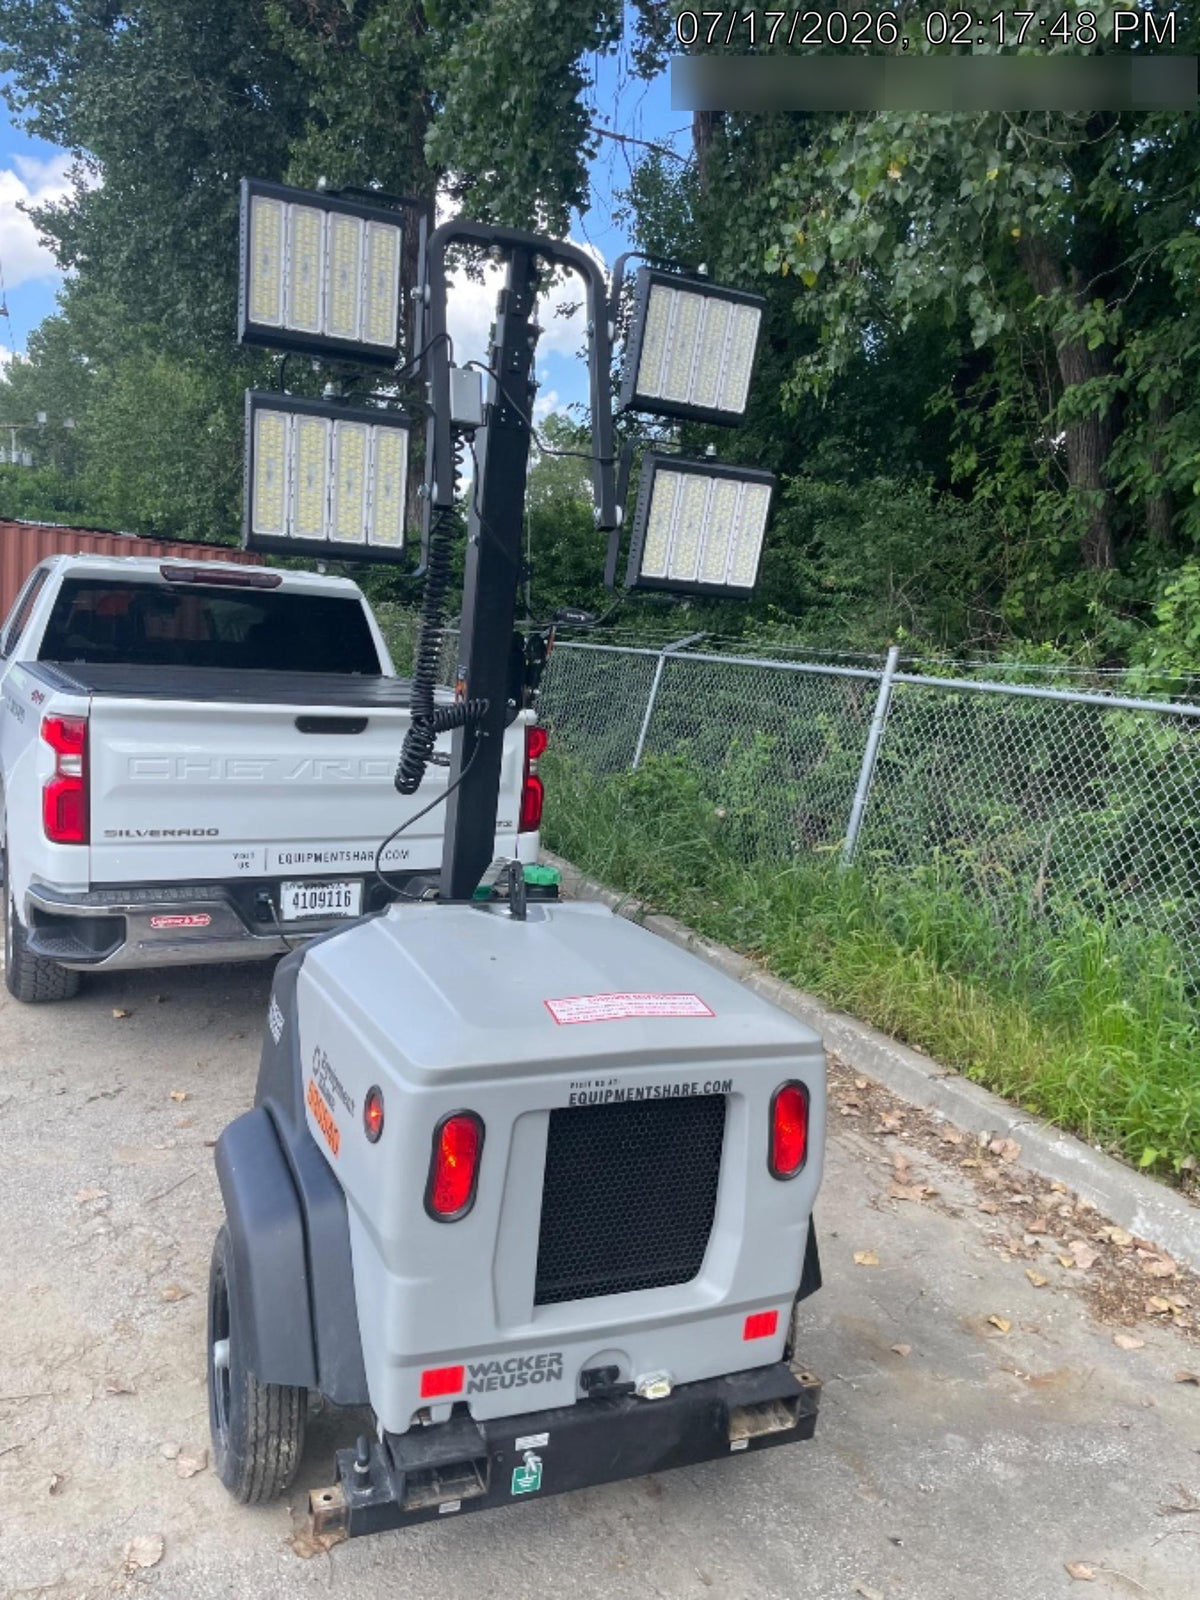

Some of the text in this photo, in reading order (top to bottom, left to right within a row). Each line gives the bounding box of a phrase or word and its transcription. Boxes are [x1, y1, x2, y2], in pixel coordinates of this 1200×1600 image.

[103, 828, 219, 838] SILVERADO
[278, 849, 410, 865] EQUIPMENTSHAR.COM
[292, 889, 352, 910] 4109116
[569, 1079, 733, 1105] EQUIPMENTSHARE.COM
[467, 1353, 563, 1379] WACKER
[467, 1366, 563, 1395] NEUSON
